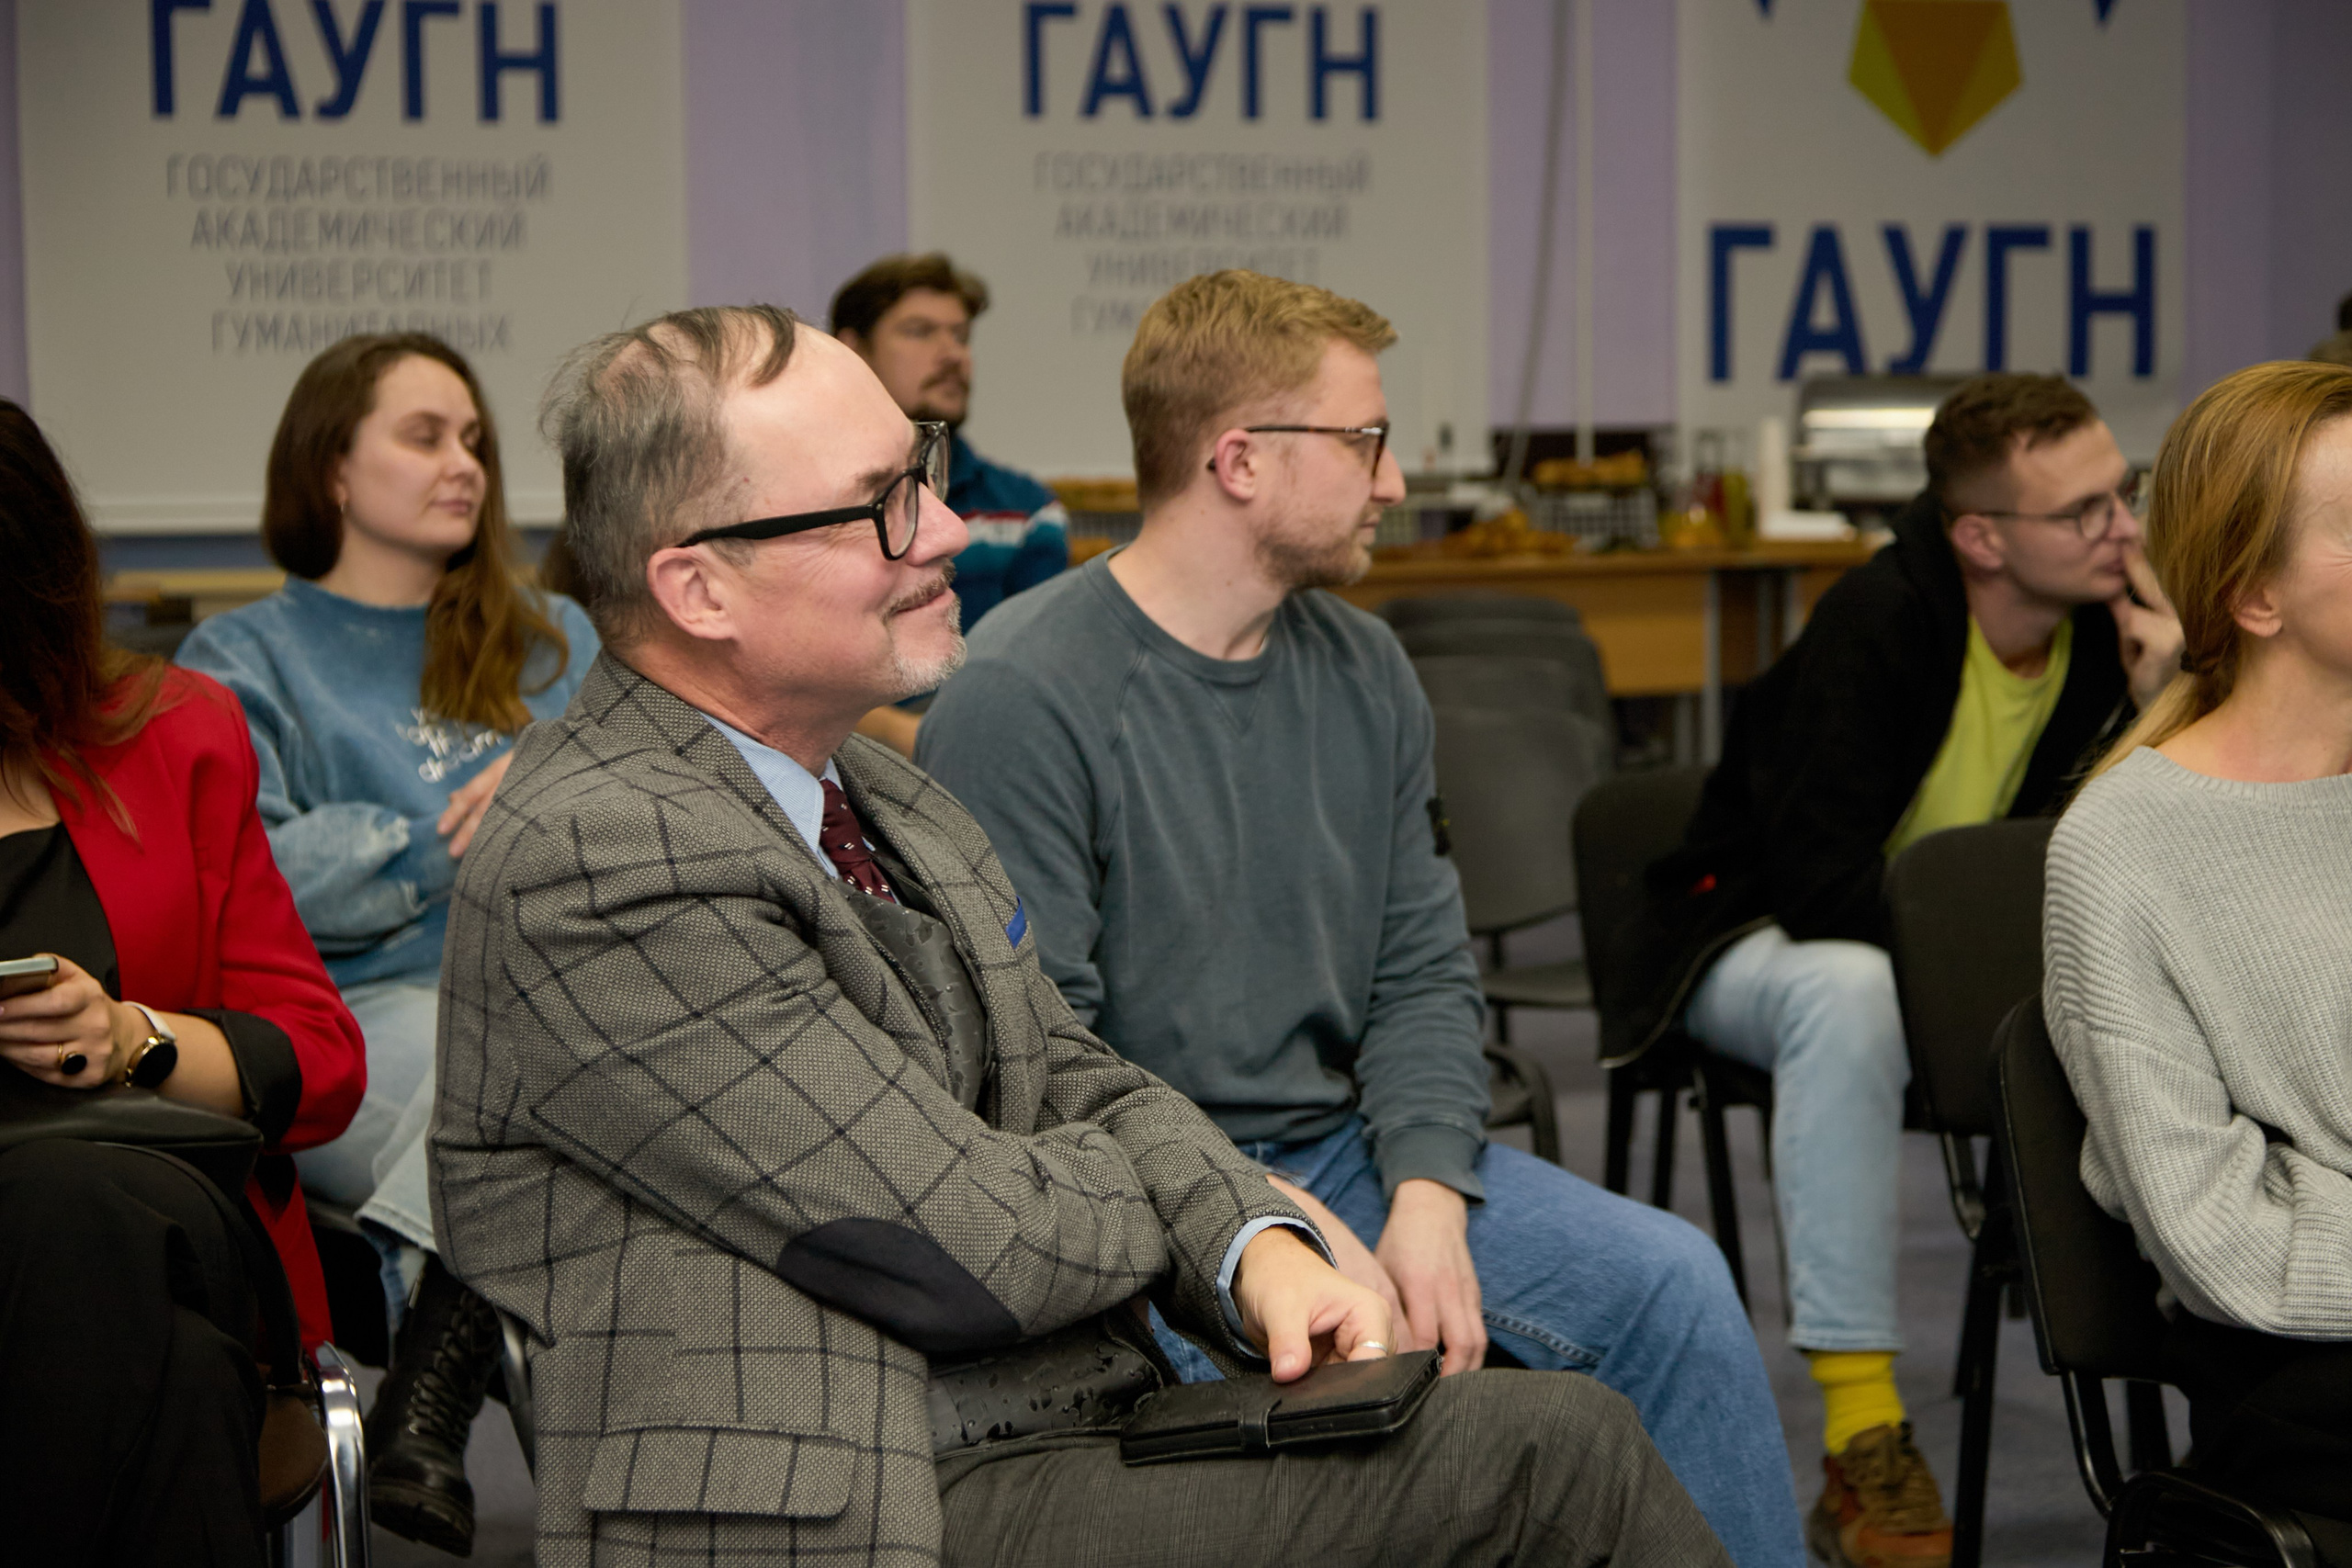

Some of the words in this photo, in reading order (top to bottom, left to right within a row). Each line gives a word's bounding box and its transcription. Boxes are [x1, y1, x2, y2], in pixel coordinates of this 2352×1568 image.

[151, 0, 560, 121] ГАУГН
[1023, 1, 1380, 121] ГАУГН
[166, 152, 550, 203] ГОСУДАРСТВЕННЫЙ
[190, 204, 527, 254] АКАДЕМИЧЕСКИЙ
[226, 258, 493, 304] УНИВЕРСИТЕТ
[1709, 222, 2156, 381] ГАУГН
